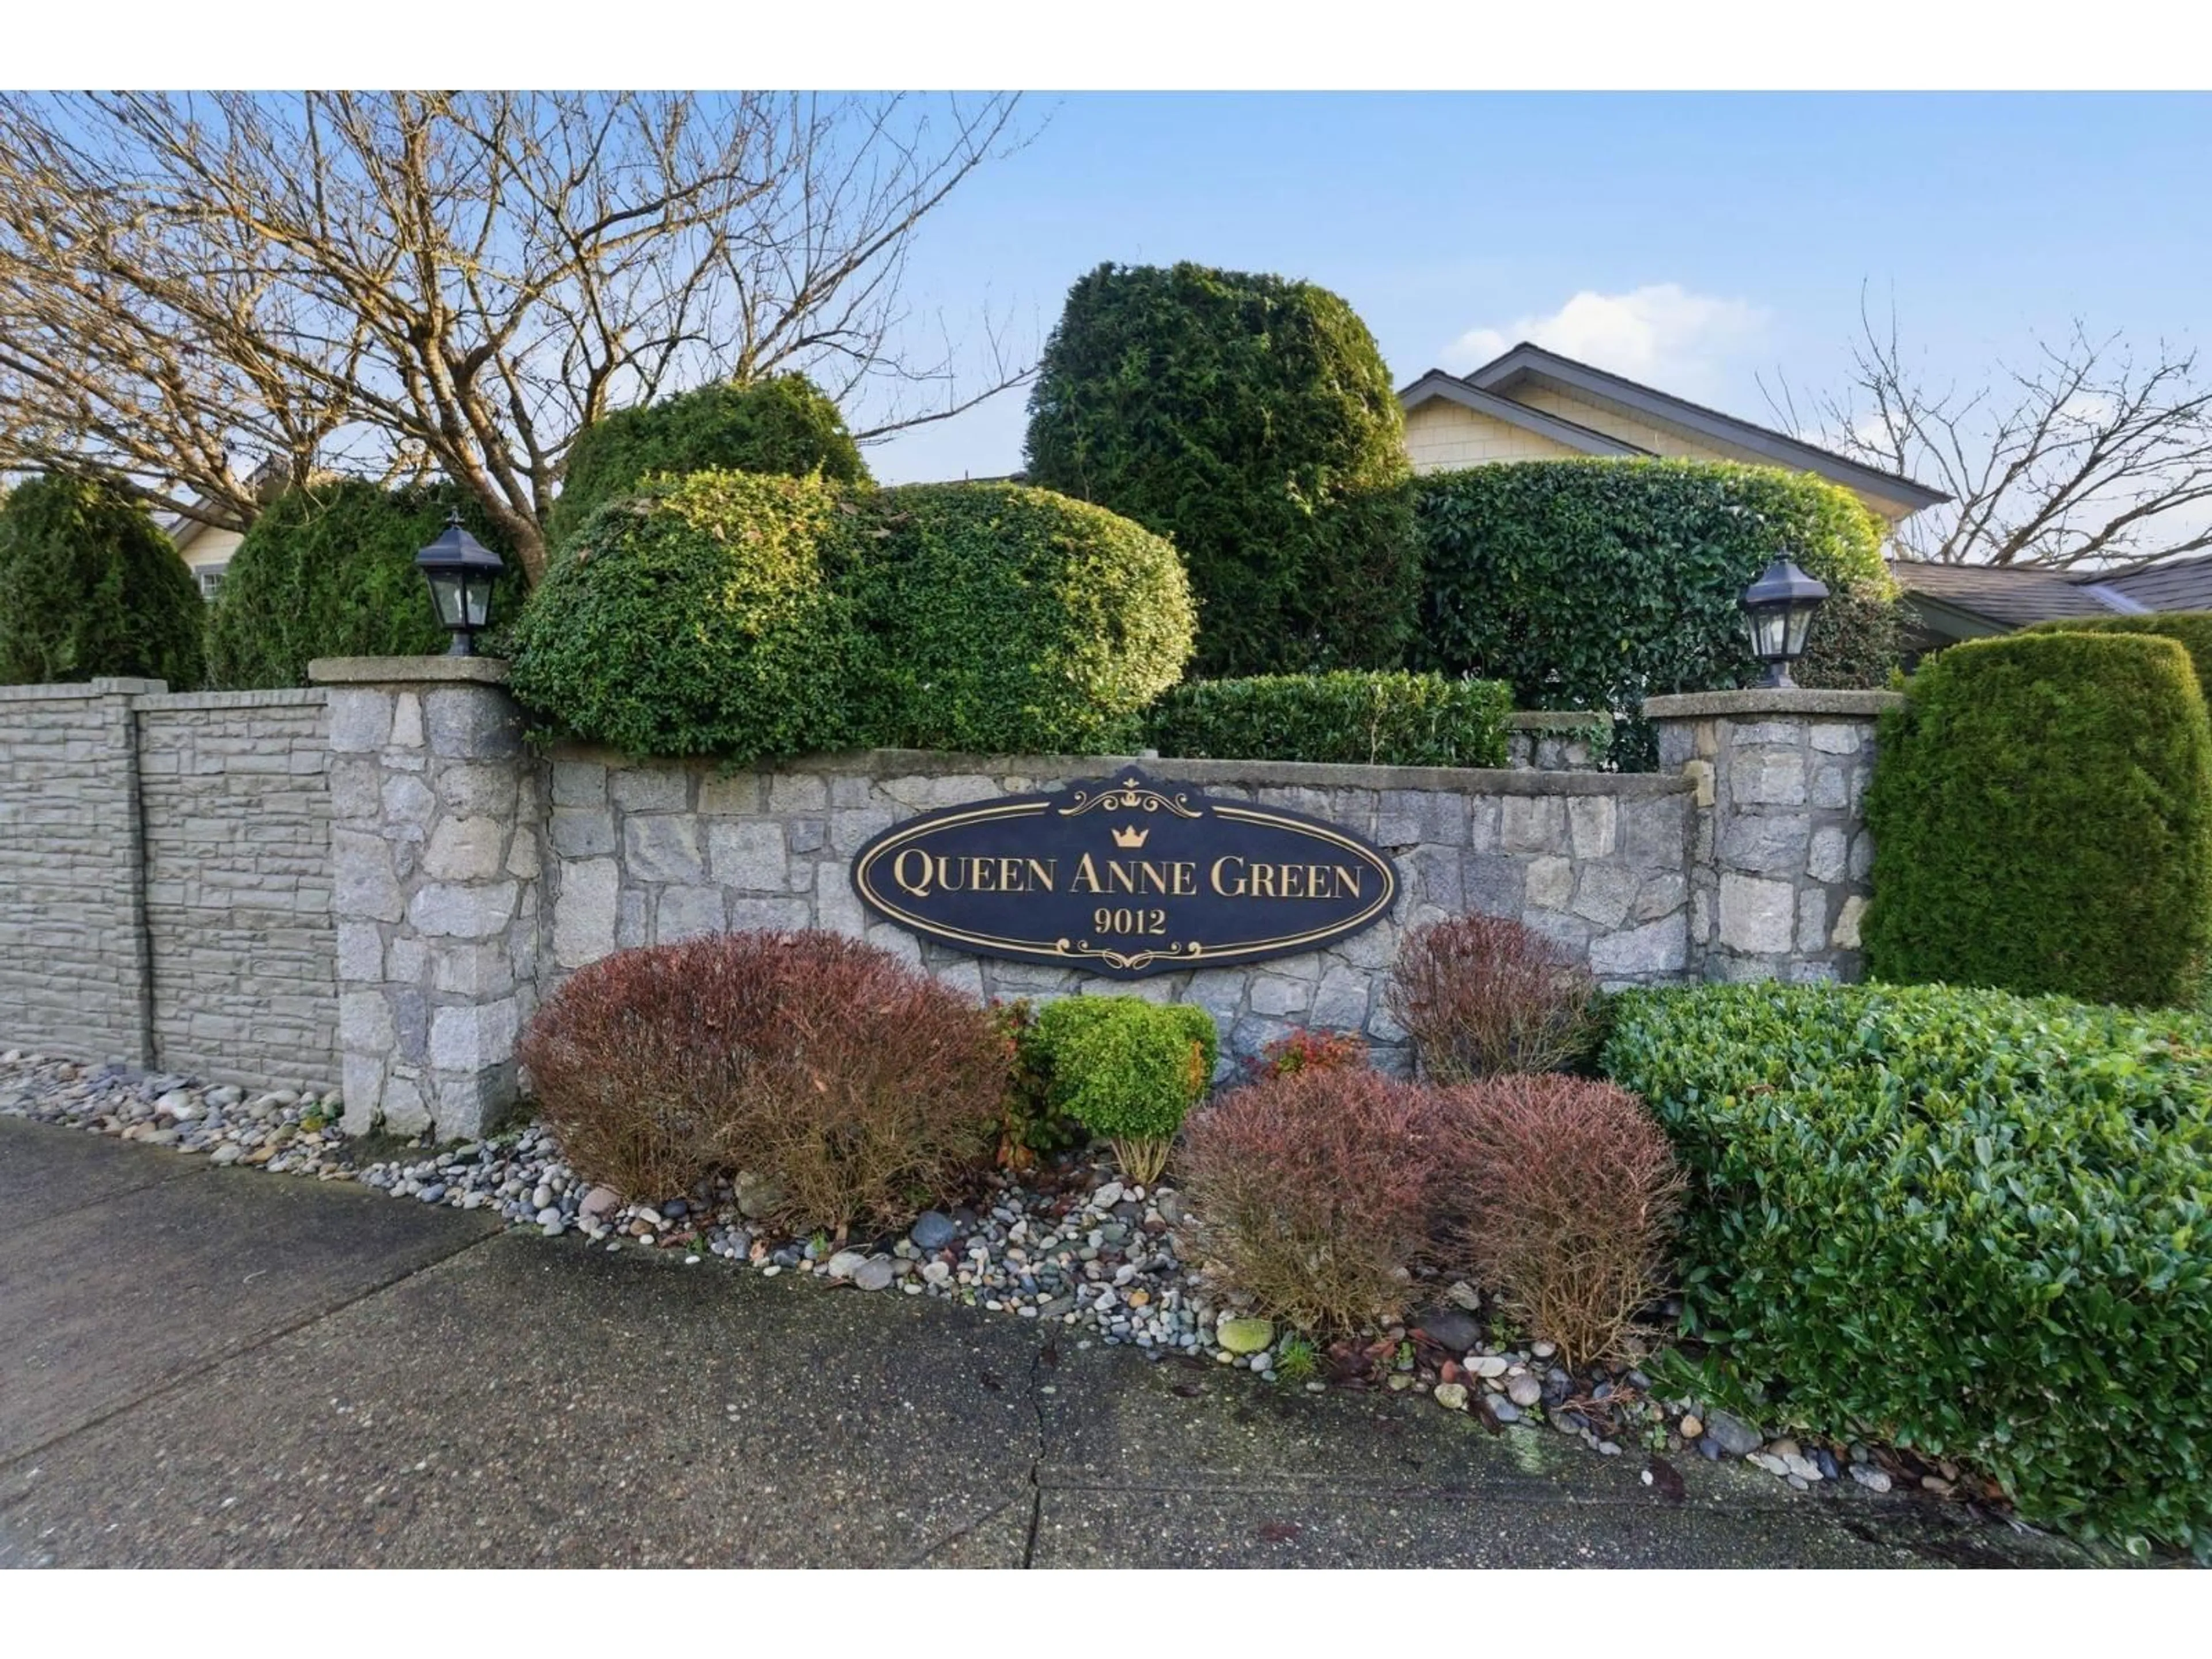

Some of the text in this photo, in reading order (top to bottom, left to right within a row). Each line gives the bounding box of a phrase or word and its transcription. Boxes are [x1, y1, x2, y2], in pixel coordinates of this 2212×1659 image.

[893, 848, 1363, 899] QUEEN ANNE GREEN
[1094, 908, 1166, 935] 9012
